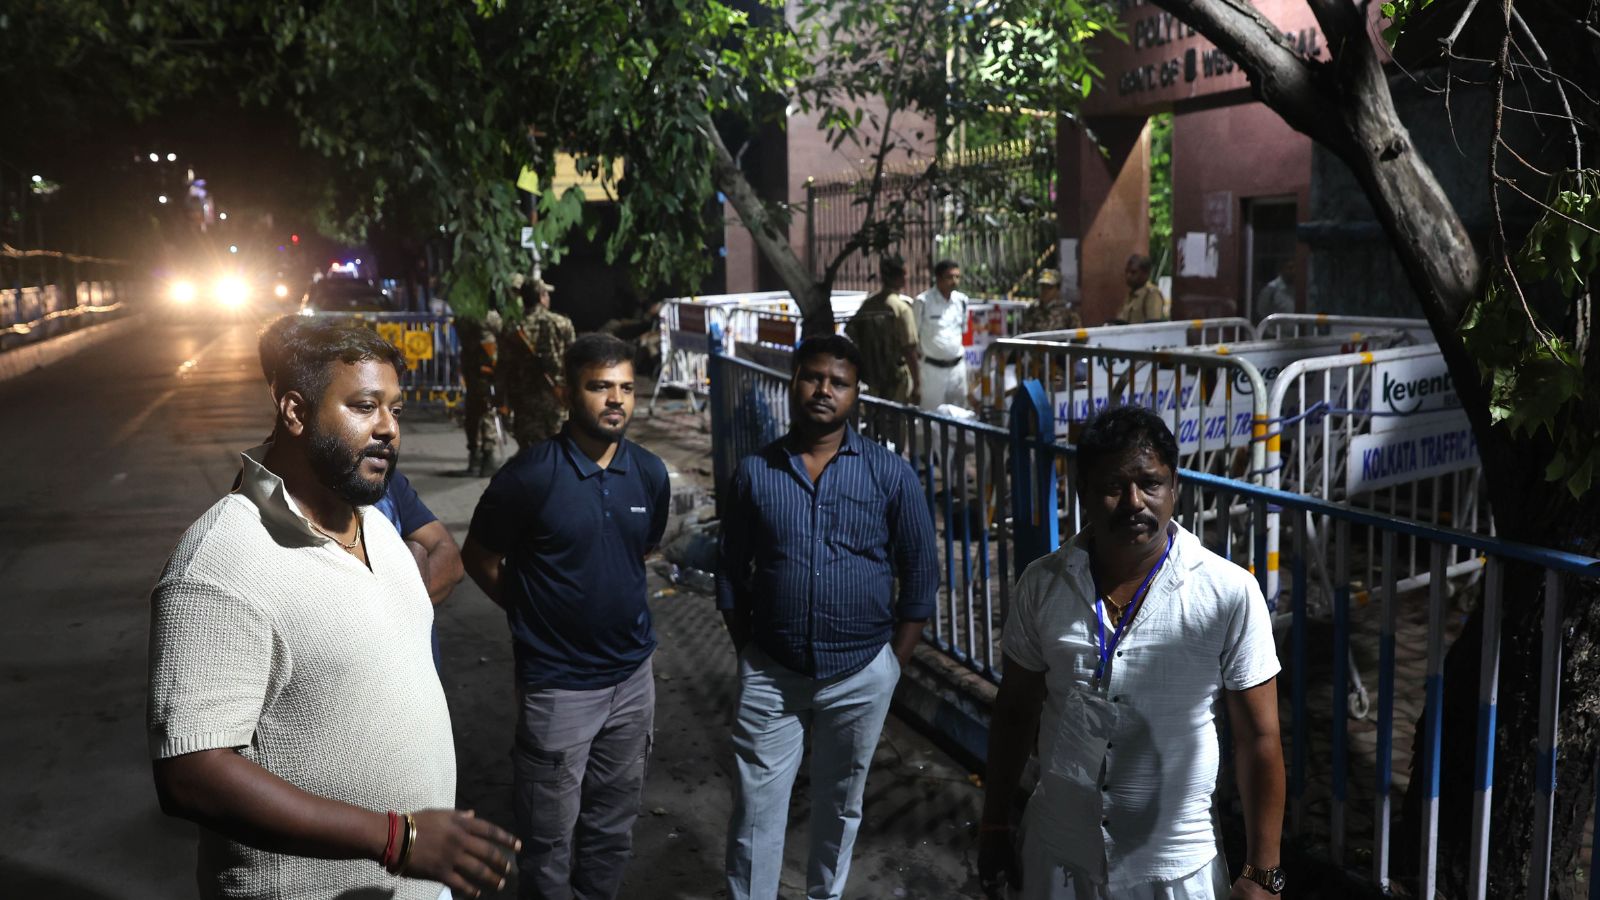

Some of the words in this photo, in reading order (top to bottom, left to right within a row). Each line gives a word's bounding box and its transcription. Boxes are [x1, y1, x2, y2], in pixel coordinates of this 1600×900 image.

[1161, 57, 1179, 88] OF
[1382, 370, 1455, 404] kevent
[1363, 440, 1417, 480] KOLKATA
[1421, 429, 1467, 469] TRAFFIC
